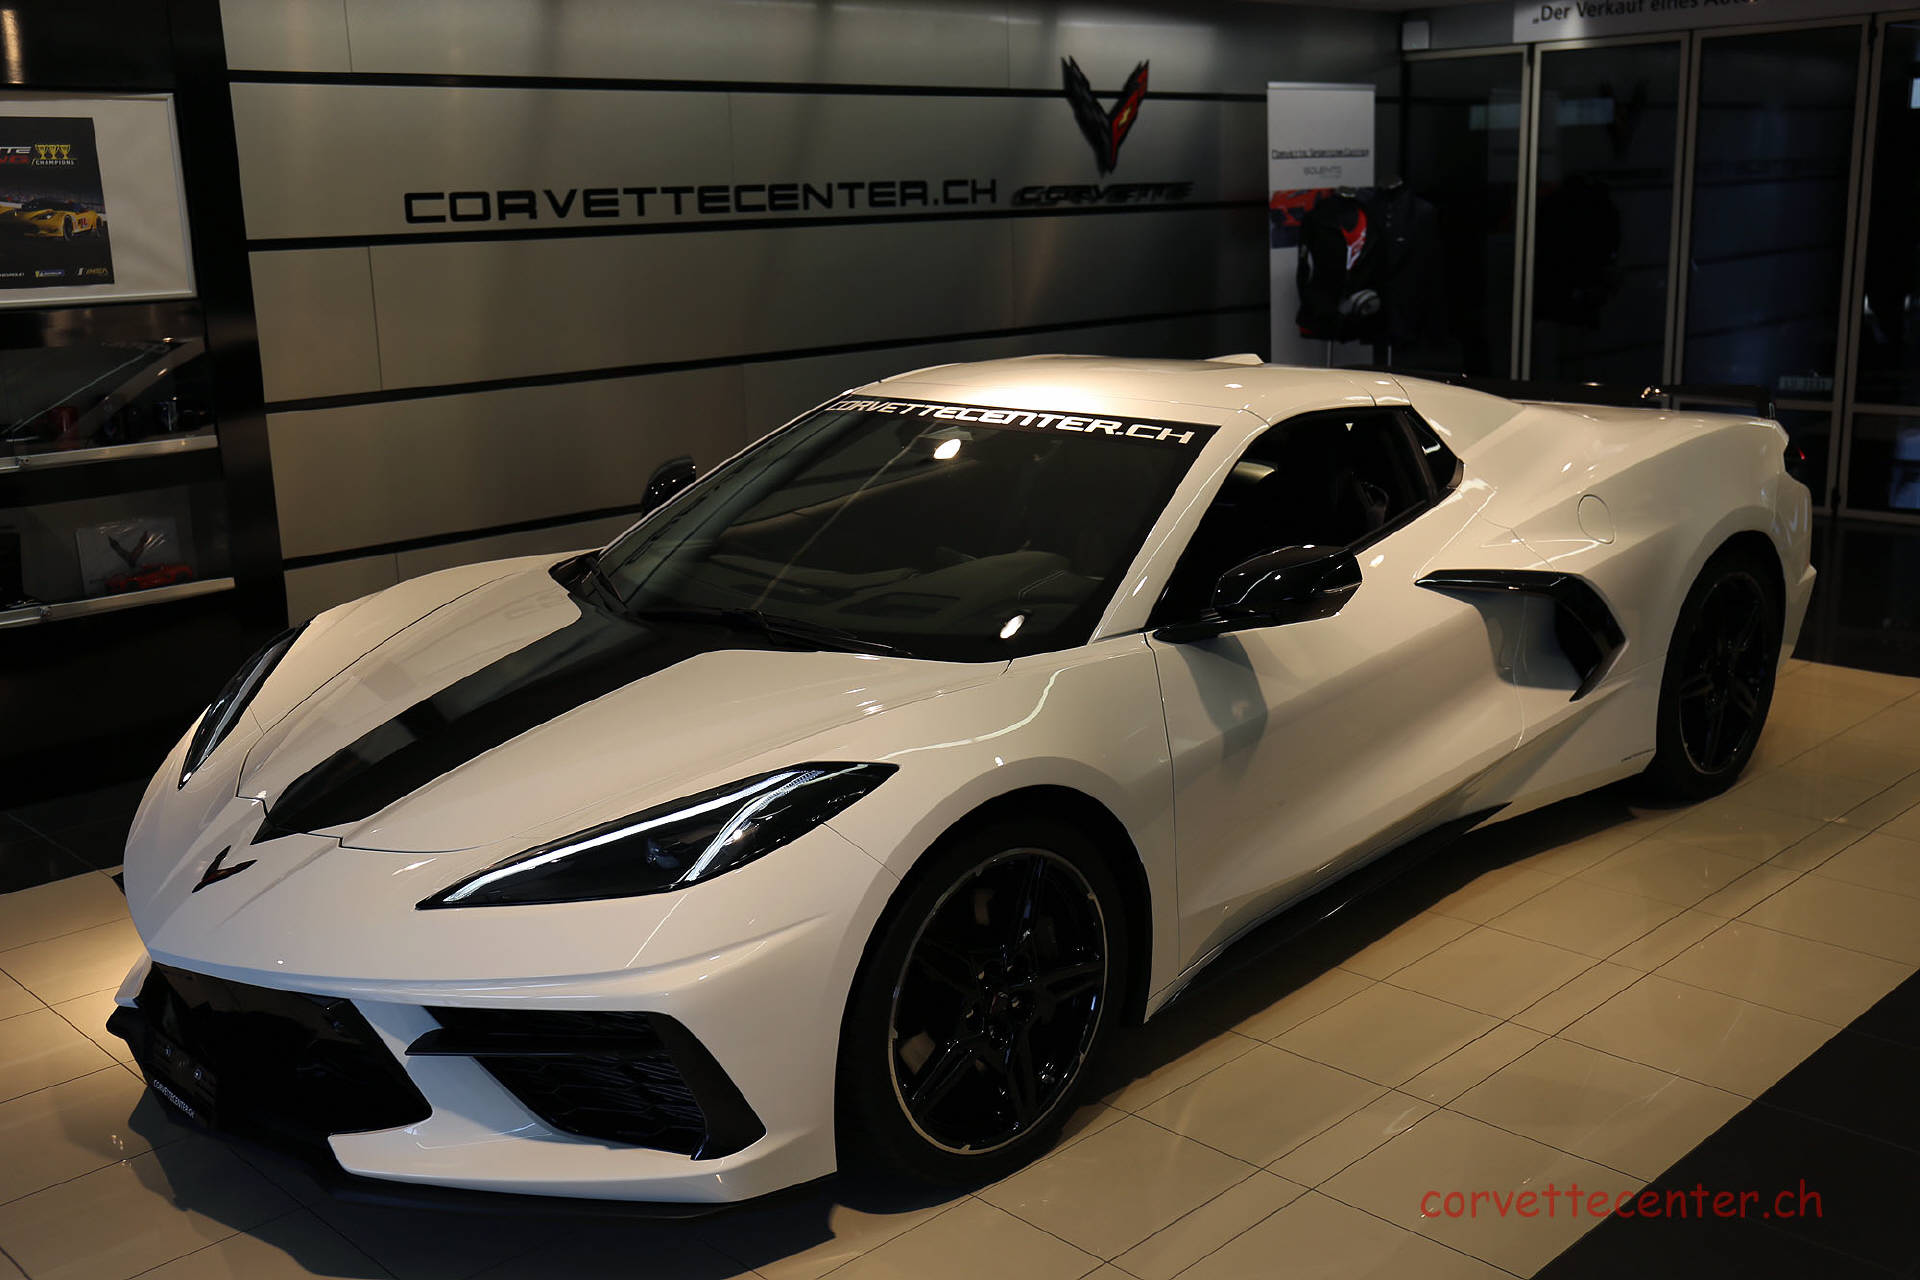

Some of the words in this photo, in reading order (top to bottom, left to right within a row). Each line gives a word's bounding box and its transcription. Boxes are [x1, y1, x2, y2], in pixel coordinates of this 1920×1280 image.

[1577, 0, 1644, 17] Verkauf
[404, 178, 997, 224] CORVETTECENTER.CH
[825, 400, 1196, 445] CORVETTECENTER.CH
